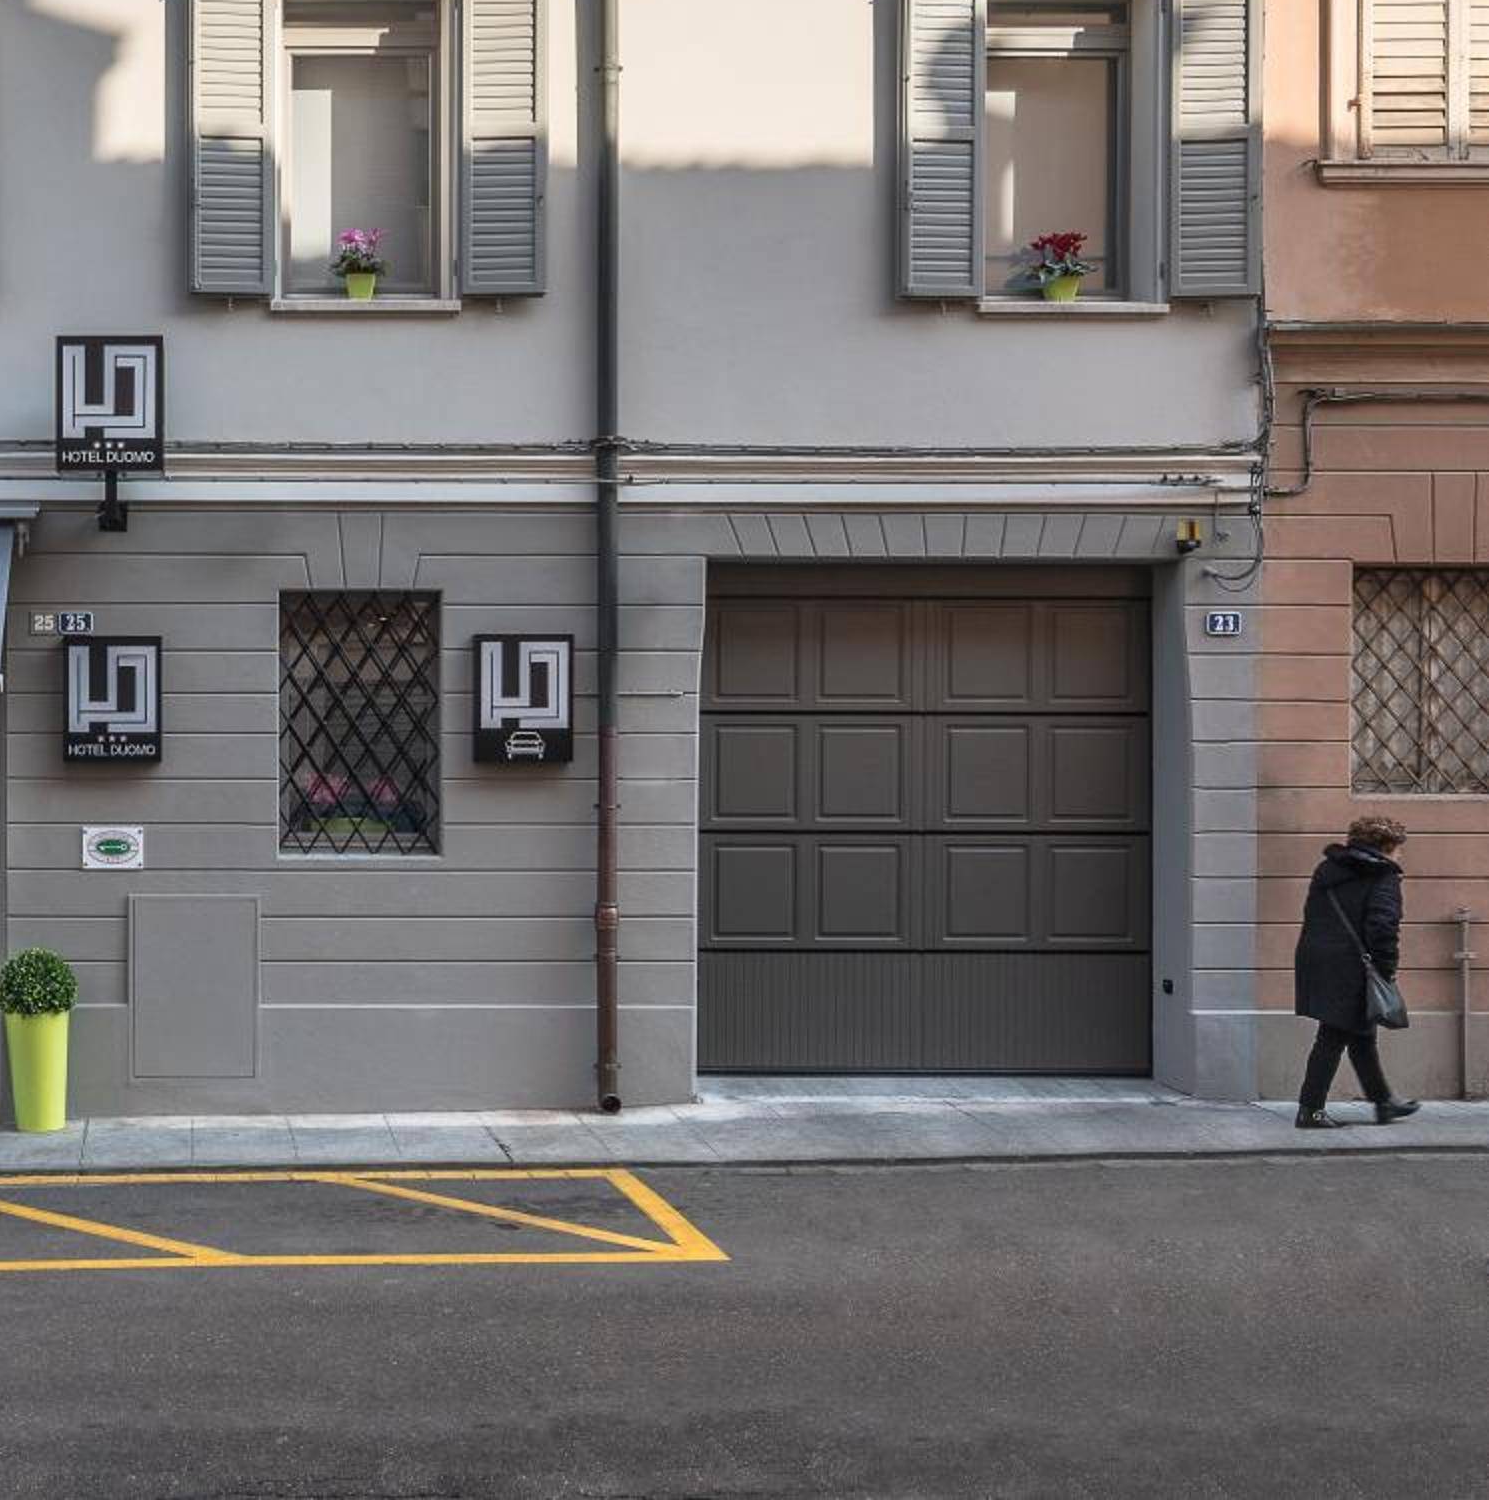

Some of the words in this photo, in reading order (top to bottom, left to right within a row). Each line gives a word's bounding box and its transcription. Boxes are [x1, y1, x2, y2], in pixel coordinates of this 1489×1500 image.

[62, 450, 105, 463] HOTEL
[106, 450, 155, 463] DUOMO
[33, 614, 54, 631] 25
[63, 614, 86, 631] 25
[1213, 614, 1235, 631] 23
[67, 743, 109, 757] HOTEL
[110, 743, 156, 757] DUOMO
